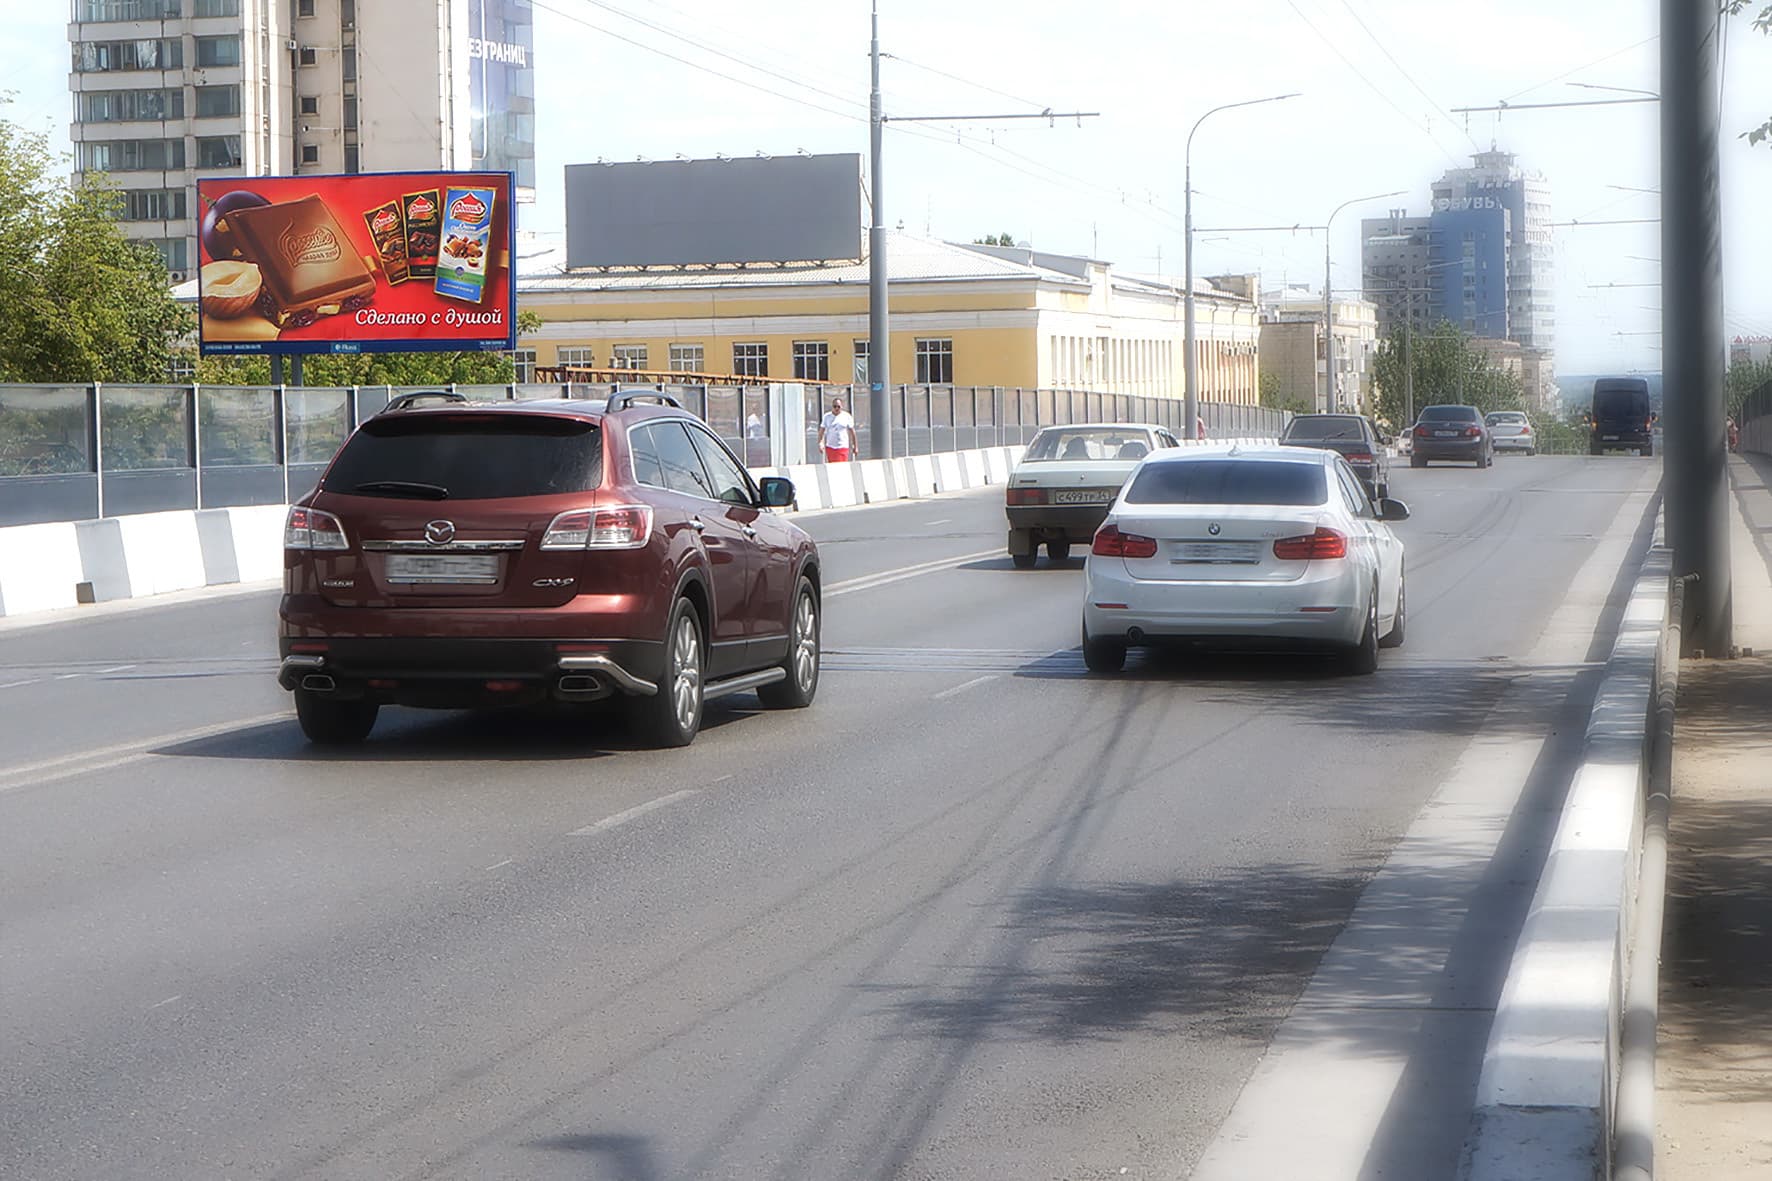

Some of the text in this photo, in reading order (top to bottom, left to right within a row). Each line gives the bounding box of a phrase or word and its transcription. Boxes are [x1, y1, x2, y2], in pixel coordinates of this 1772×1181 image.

[483, 40, 526, 68] ГРАНИЦ
[355, 308, 502, 328] Сделано с душой
